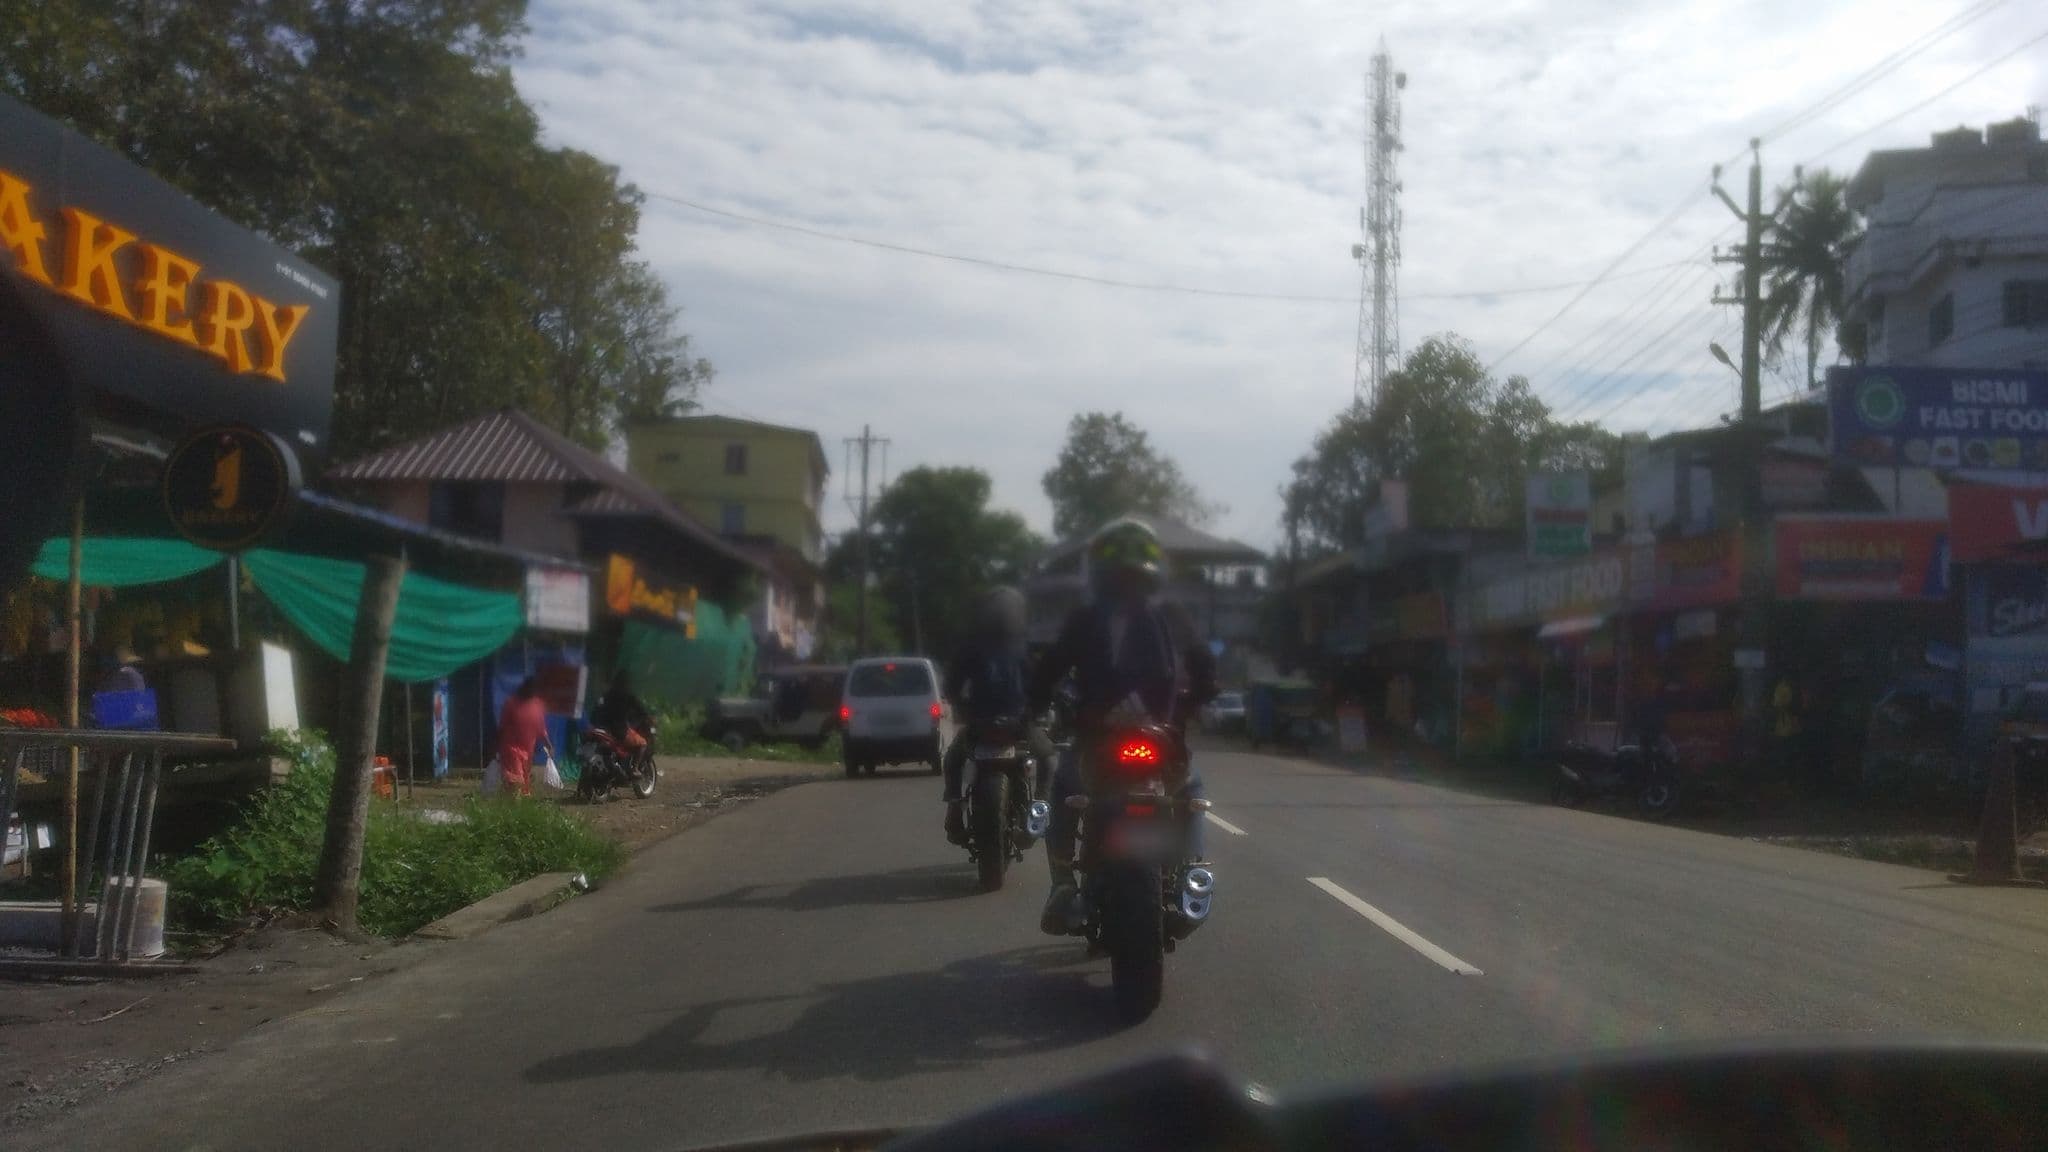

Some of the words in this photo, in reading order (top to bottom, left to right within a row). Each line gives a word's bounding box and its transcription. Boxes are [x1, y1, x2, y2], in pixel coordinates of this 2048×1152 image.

[1952, 379, 2028, 404] BISMI
[1920, 406, 1983, 430] FAST
[1991, 408, 2048, 431] FOO
